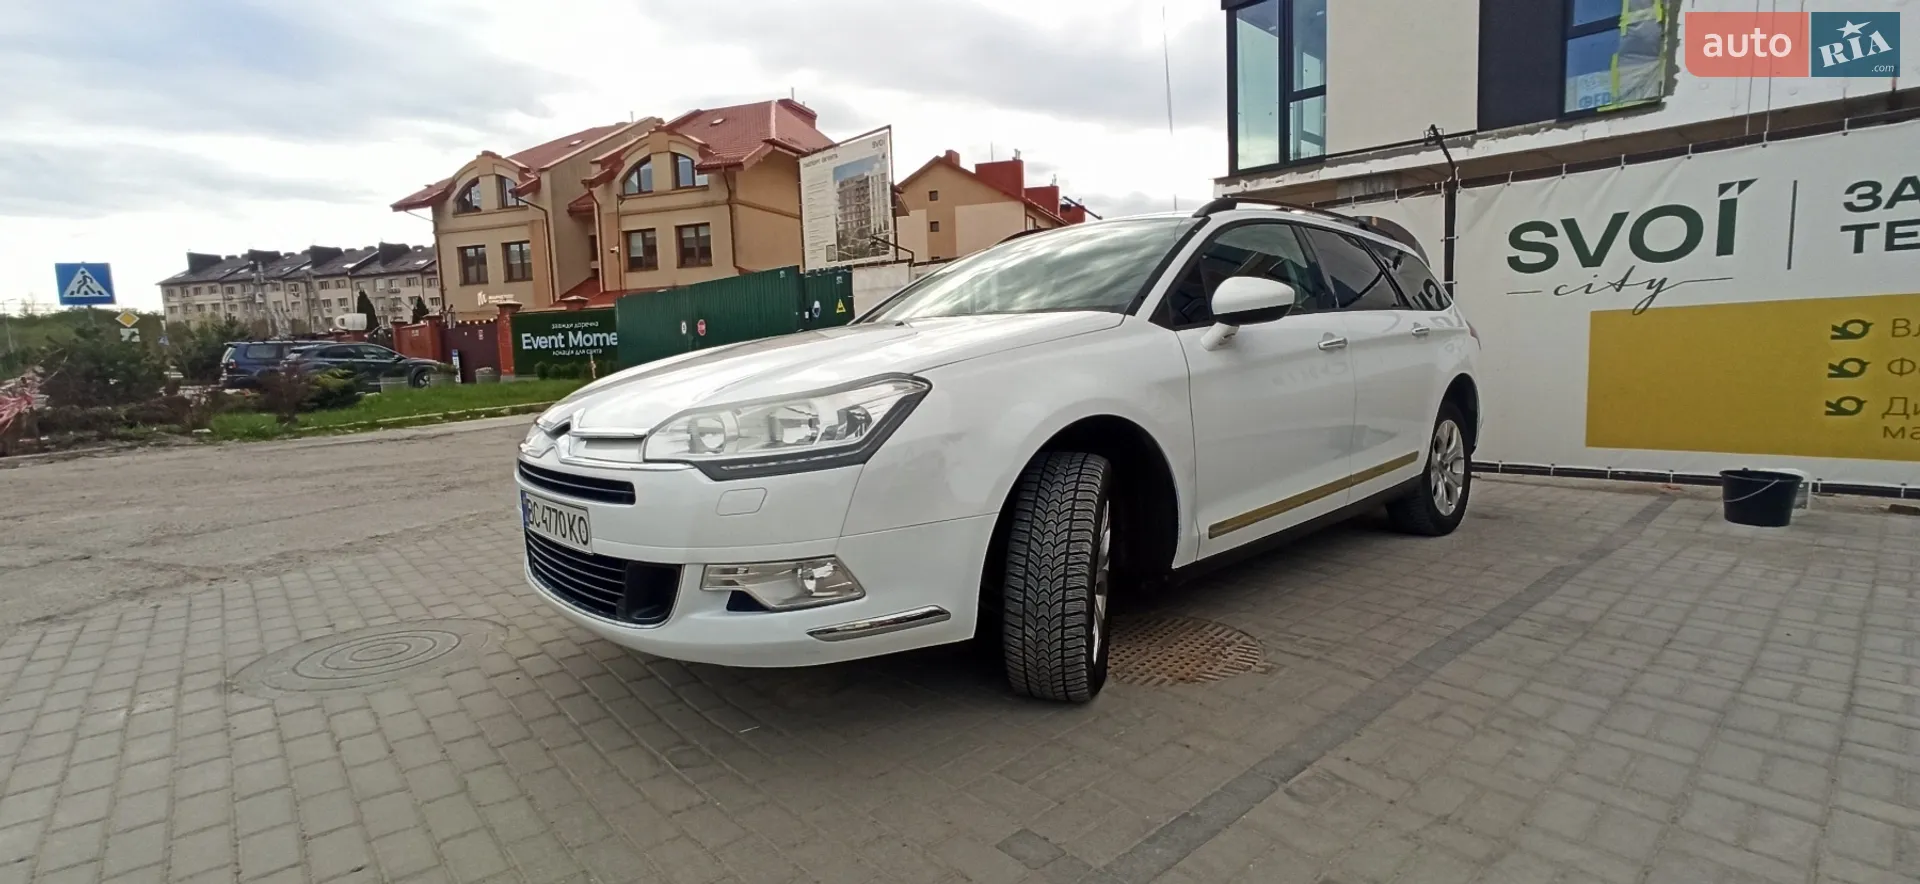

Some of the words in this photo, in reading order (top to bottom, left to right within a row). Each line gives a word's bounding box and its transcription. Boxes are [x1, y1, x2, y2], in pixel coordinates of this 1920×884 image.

[1840, 218, 1920, 254] ТЕ
[1553, 265, 1732, 315] city
[521, 332, 565, 350] Event
[568, 330, 618, 348] Mome
